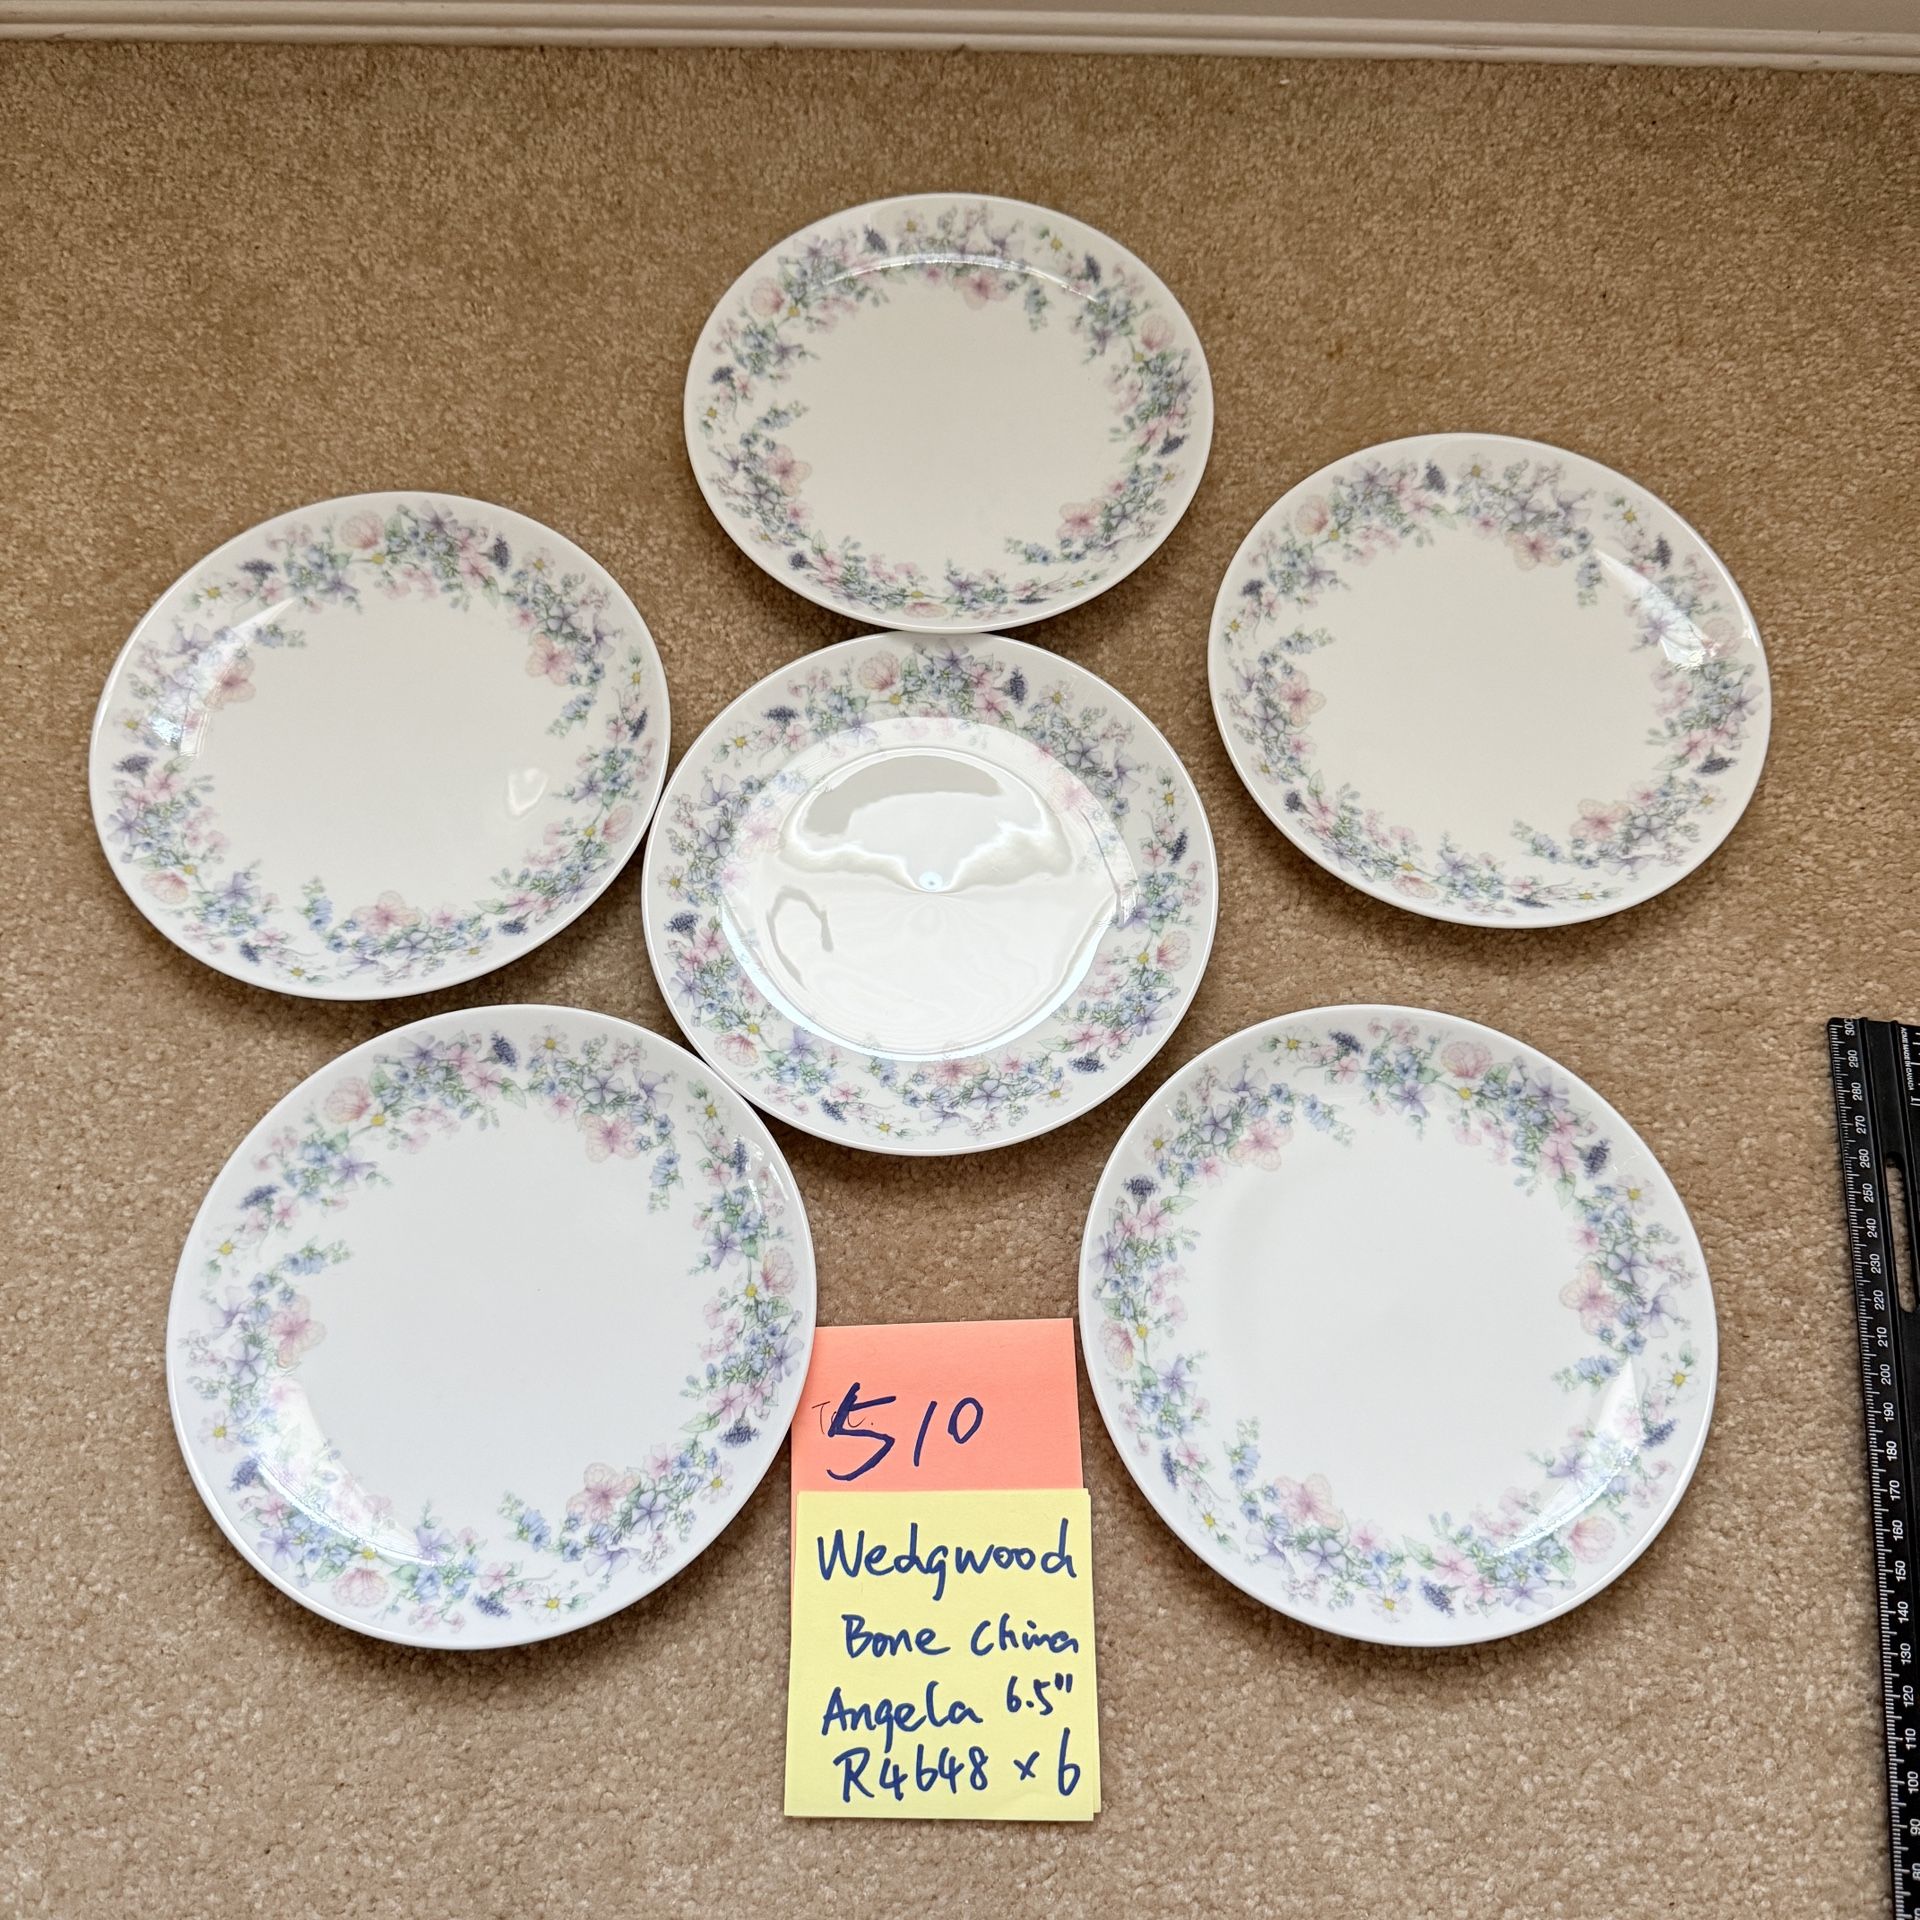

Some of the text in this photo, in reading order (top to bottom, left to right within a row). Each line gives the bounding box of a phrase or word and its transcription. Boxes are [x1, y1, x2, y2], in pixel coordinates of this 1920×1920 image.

[1844, 1018, 1855, 1036] 300
[1848, 1049, 1859, 1068] 290
[1902, 1043, 1910, 1060] MADE
[1905, 1067, 1915, 1091] CANADA
[1851, 1082, 1862, 1101] 280
[1855, 1115, 1867, 1134] 270
[1859, 1148, 1871, 1168] 260
[1862, 1183, 1874, 1203] 250
[1866, 1218, 1878, 1238] 240
[1869, 1253, 1881, 1274] 230
[1873, 1290, 1885, 1310] 220
[1876, 1326, 1888, 1348] 210
[1880, 1363, 1892, 1385] 200
[1883, 1402, 1895, 1422] 190
[826, 1382, 984, 1482] 510
[1886, 1440, 1897, 1461] 180
[1889, 1480, 1900, 1501] 170
[1892, 1520, 1903, 1541] 160
[817, 1517, 1077, 1601] Wedgwood
[1895, 1560, 1907, 1582] 150
[1897, 1601, 1909, 1624] 140
[841, 1613, 1079, 1658] Bone China
[1900, 1643, 1911, 1665] 130
[1903, 1685, 1914, 1707] 120
[821, 1680, 984, 1753] Angela
[1905, 1728, 1917, 1750] 110
[833, 1744, 989, 1803] R4648
[1058, 1727, 1081, 1796] 6
[1907, 1771, 1919, 1794] 100
[1909, 1818, 1920, 1836] 90
